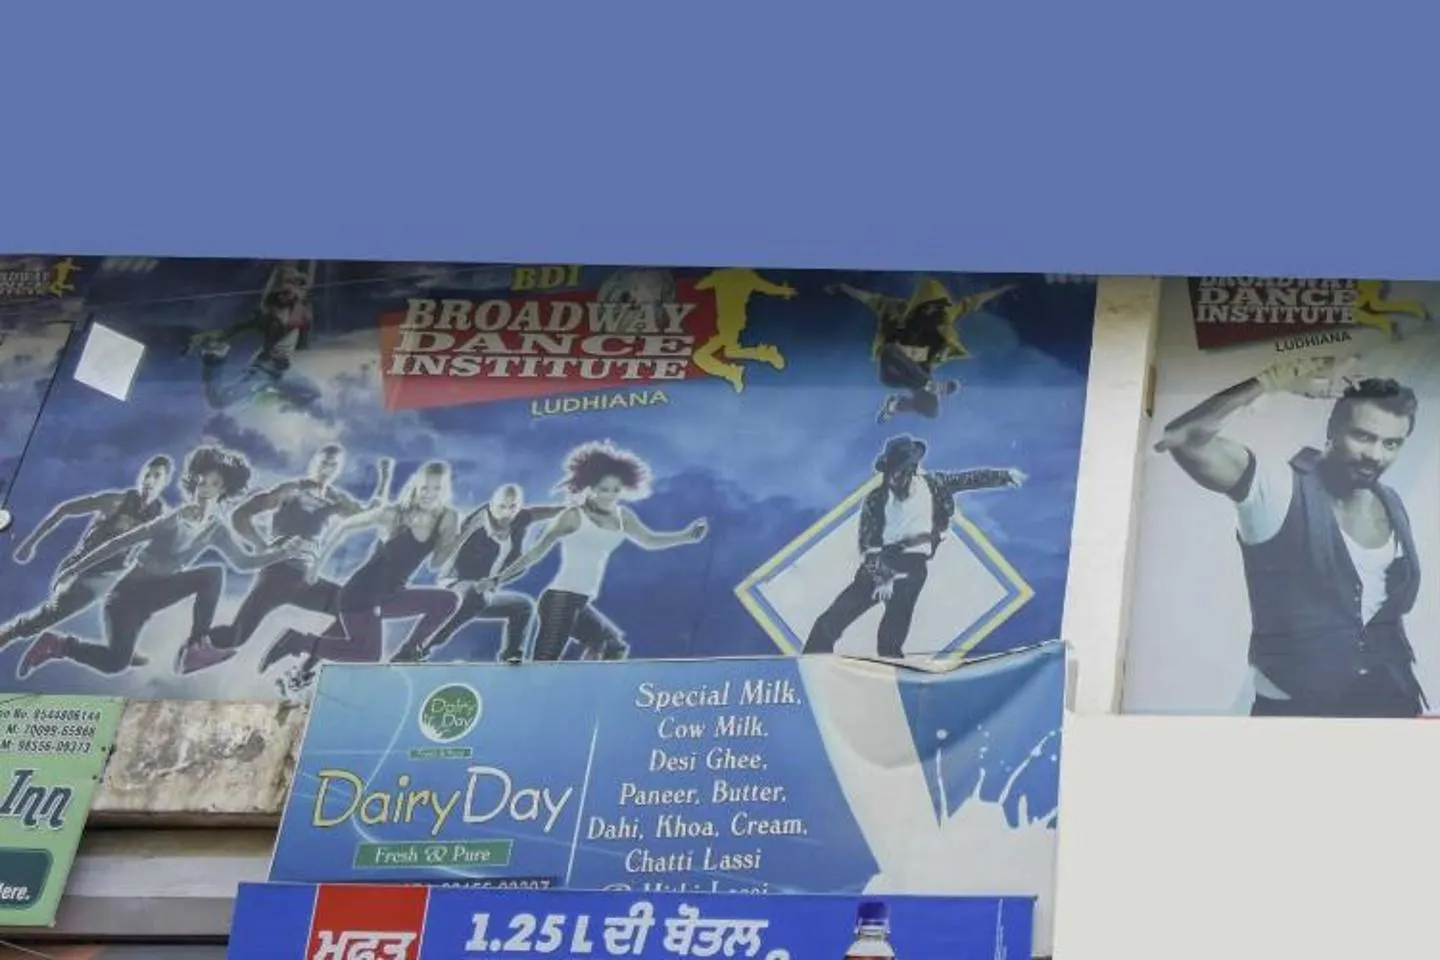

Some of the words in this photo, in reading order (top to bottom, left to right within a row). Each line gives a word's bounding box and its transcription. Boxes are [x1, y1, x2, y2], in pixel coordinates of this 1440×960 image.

[511, 265, 581, 291] BDI
[1200, 287, 1356, 305] DANCE
[400, 299, 697, 332] BROADWAY
[1196, 304, 1355, 324] INSTITUTE
[396, 331, 694, 356] DANCE
[1274, 329, 1353, 352] LUDHIANA
[387, 354, 690, 381] INSTITUTE
[531, 388, 670, 417] LUDHIANA
[635, 680, 730, 711] Special
[657, 717, 707, 739] Cow
[649, 748, 698, 771] Desi
[0, 769, 73, 828] Inn
[374, 846, 418, 864] Fresh
[451, 845, 492, 862] Pure
[624, 848, 694, 873] Chatti
[703, 846, 762, 871] Lassi
[0, 882, 30, 901] ere.
